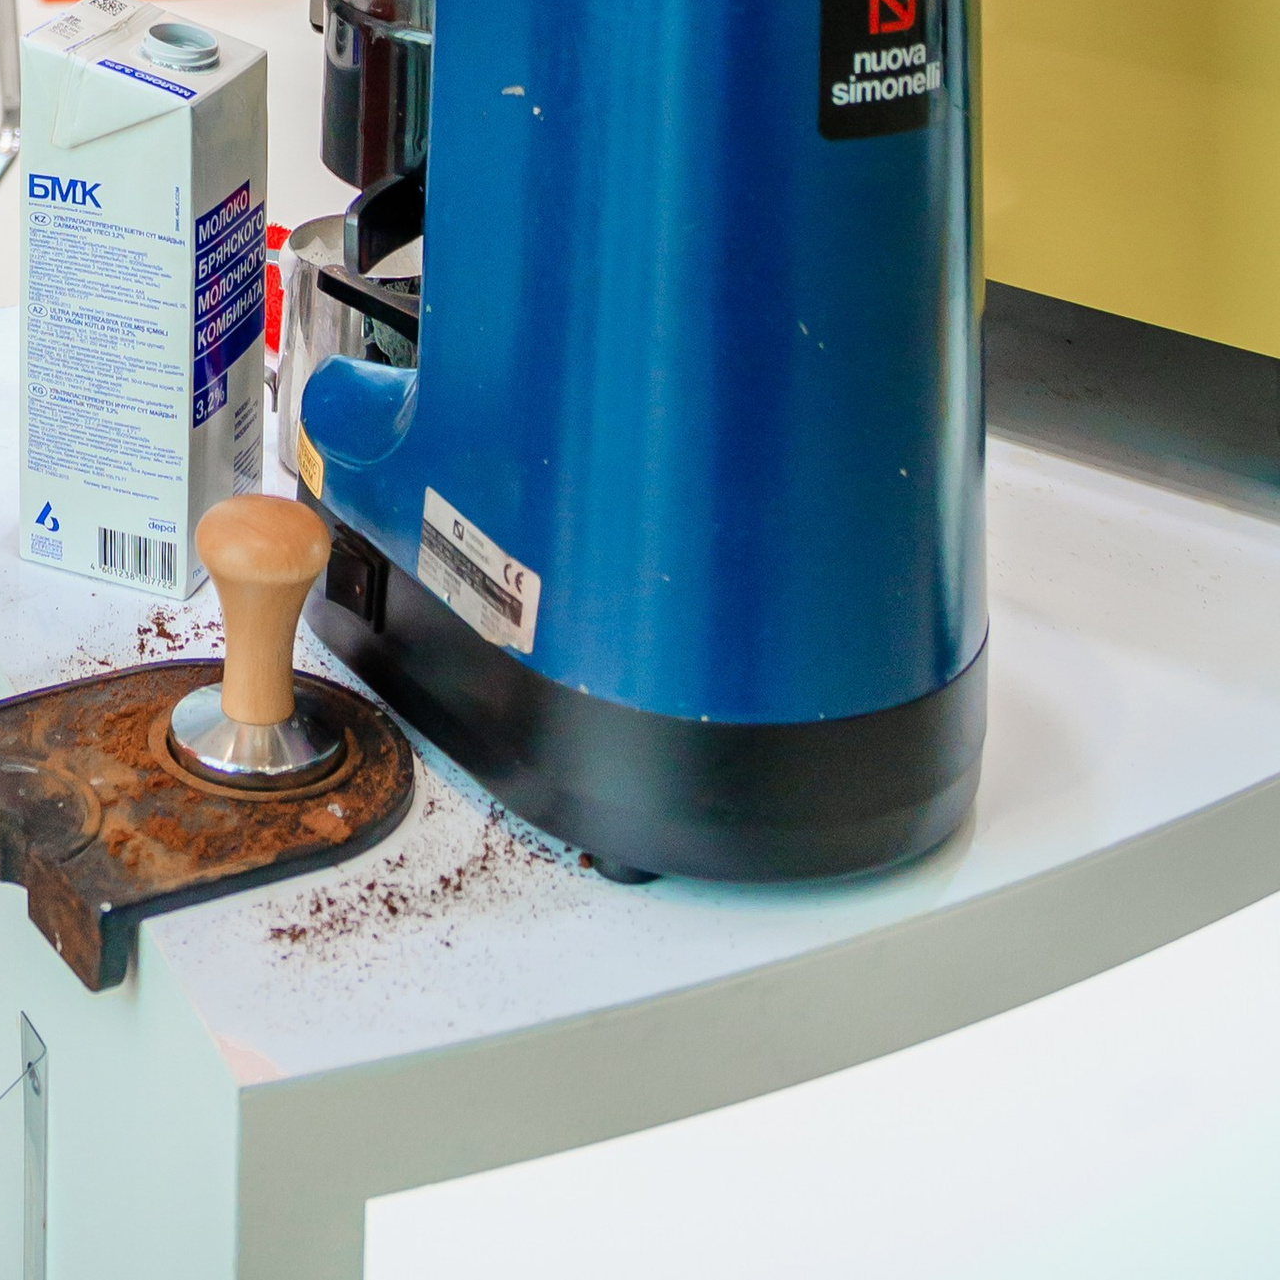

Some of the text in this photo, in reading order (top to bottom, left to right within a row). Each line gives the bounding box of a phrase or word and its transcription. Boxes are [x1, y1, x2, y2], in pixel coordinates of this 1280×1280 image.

[853, 43, 926, 74] nuova
[135, 72, 191, 97] МОЛОКО
[831, 61, 941, 106] simonelli
[28, 173, 102, 209] БМК
[33, 214, 47, 224] KZ
[199, 190, 248, 244] МОЛОКО
[198, 209, 264, 280] БРЯНСКОГО
[198, 242, 265, 315] МОЛОЧНОГО
[32, 306, 43, 315] AZ
[197, 279, 263, 350] КОМБИНАТА
[32, 386, 44, 395] KG
[195, 383, 225, 420] 3,2%
[148, 521, 177, 534] depot
[101, 565, 135, 581] 601238
[139, 574, 174, 590] 007722
